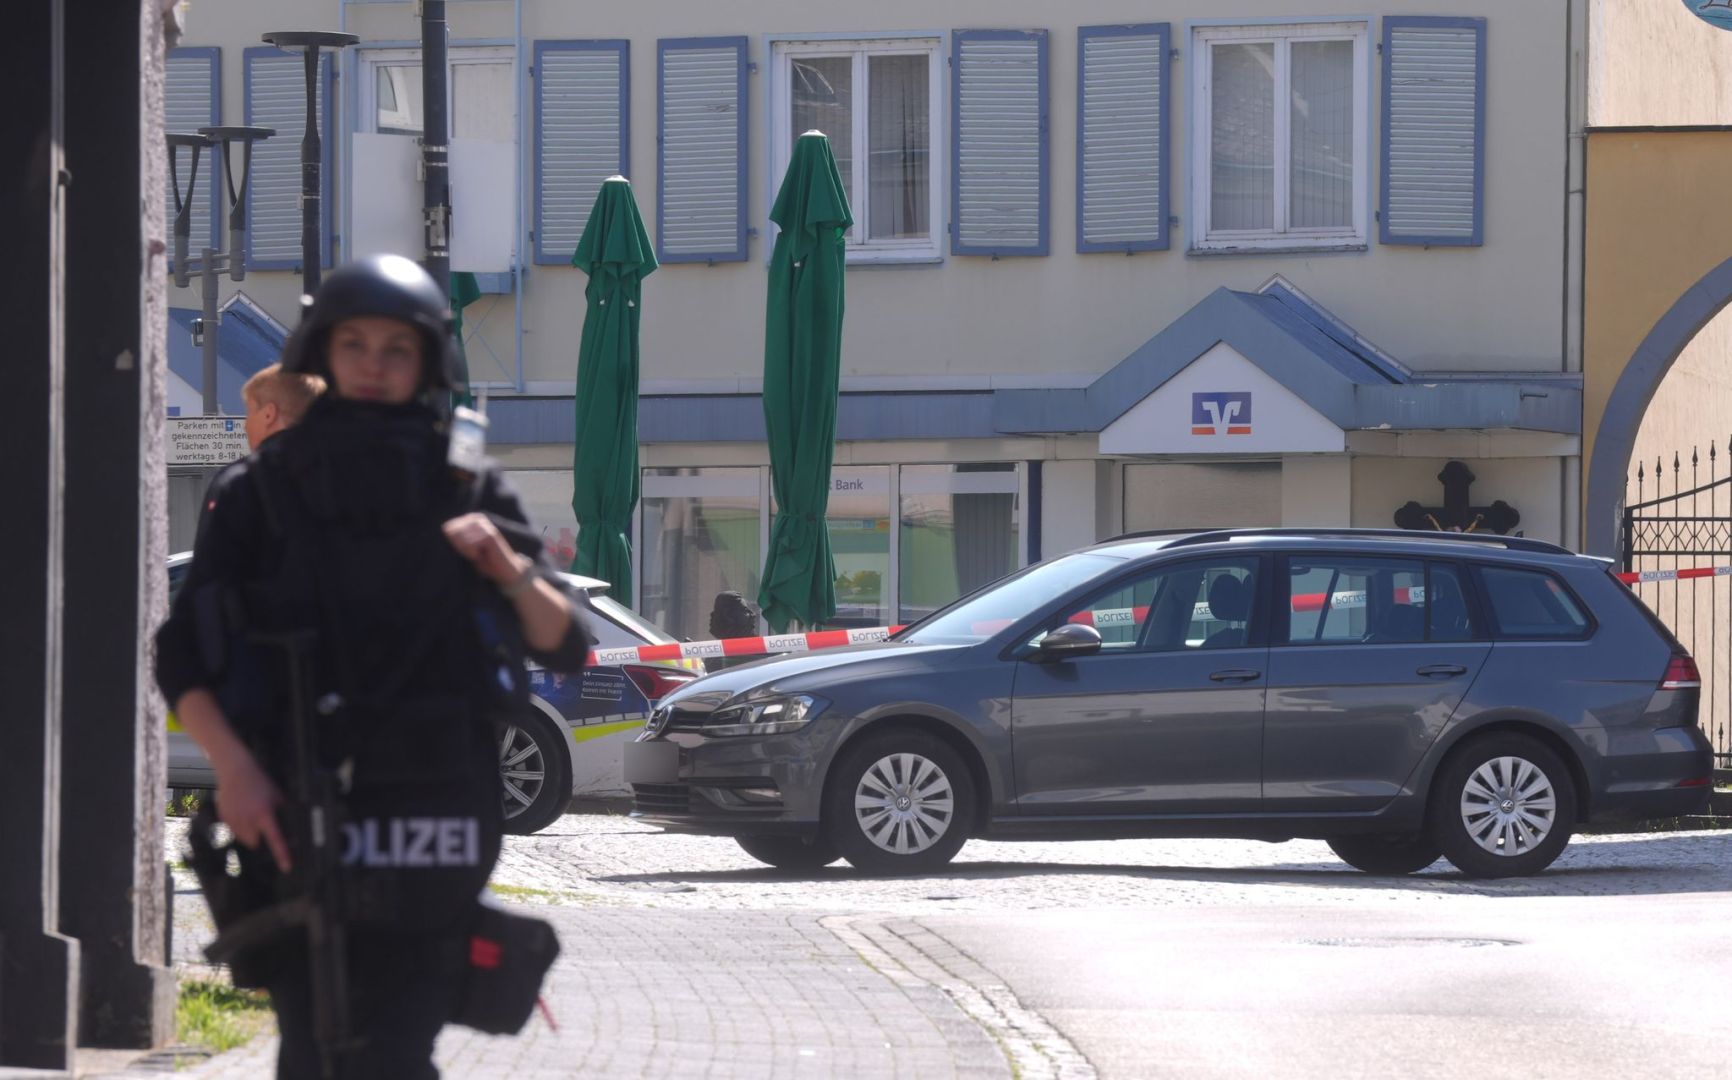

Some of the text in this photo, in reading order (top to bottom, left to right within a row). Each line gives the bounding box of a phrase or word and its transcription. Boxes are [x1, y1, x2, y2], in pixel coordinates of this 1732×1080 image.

[177, 421, 208, 430] Parken
[211, 421, 224, 429] mit
[171, 432, 248, 442] gekennzeichneten
[176, 442, 209, 450] Flächen
[212, 441, 223, 450] 30
[175, 452, 215, 461] werktags
[218, 452, 236, 460] 8-18
[835, 478, 864, 490] Bank
[342, 816, 480, 867] OLIZEI
